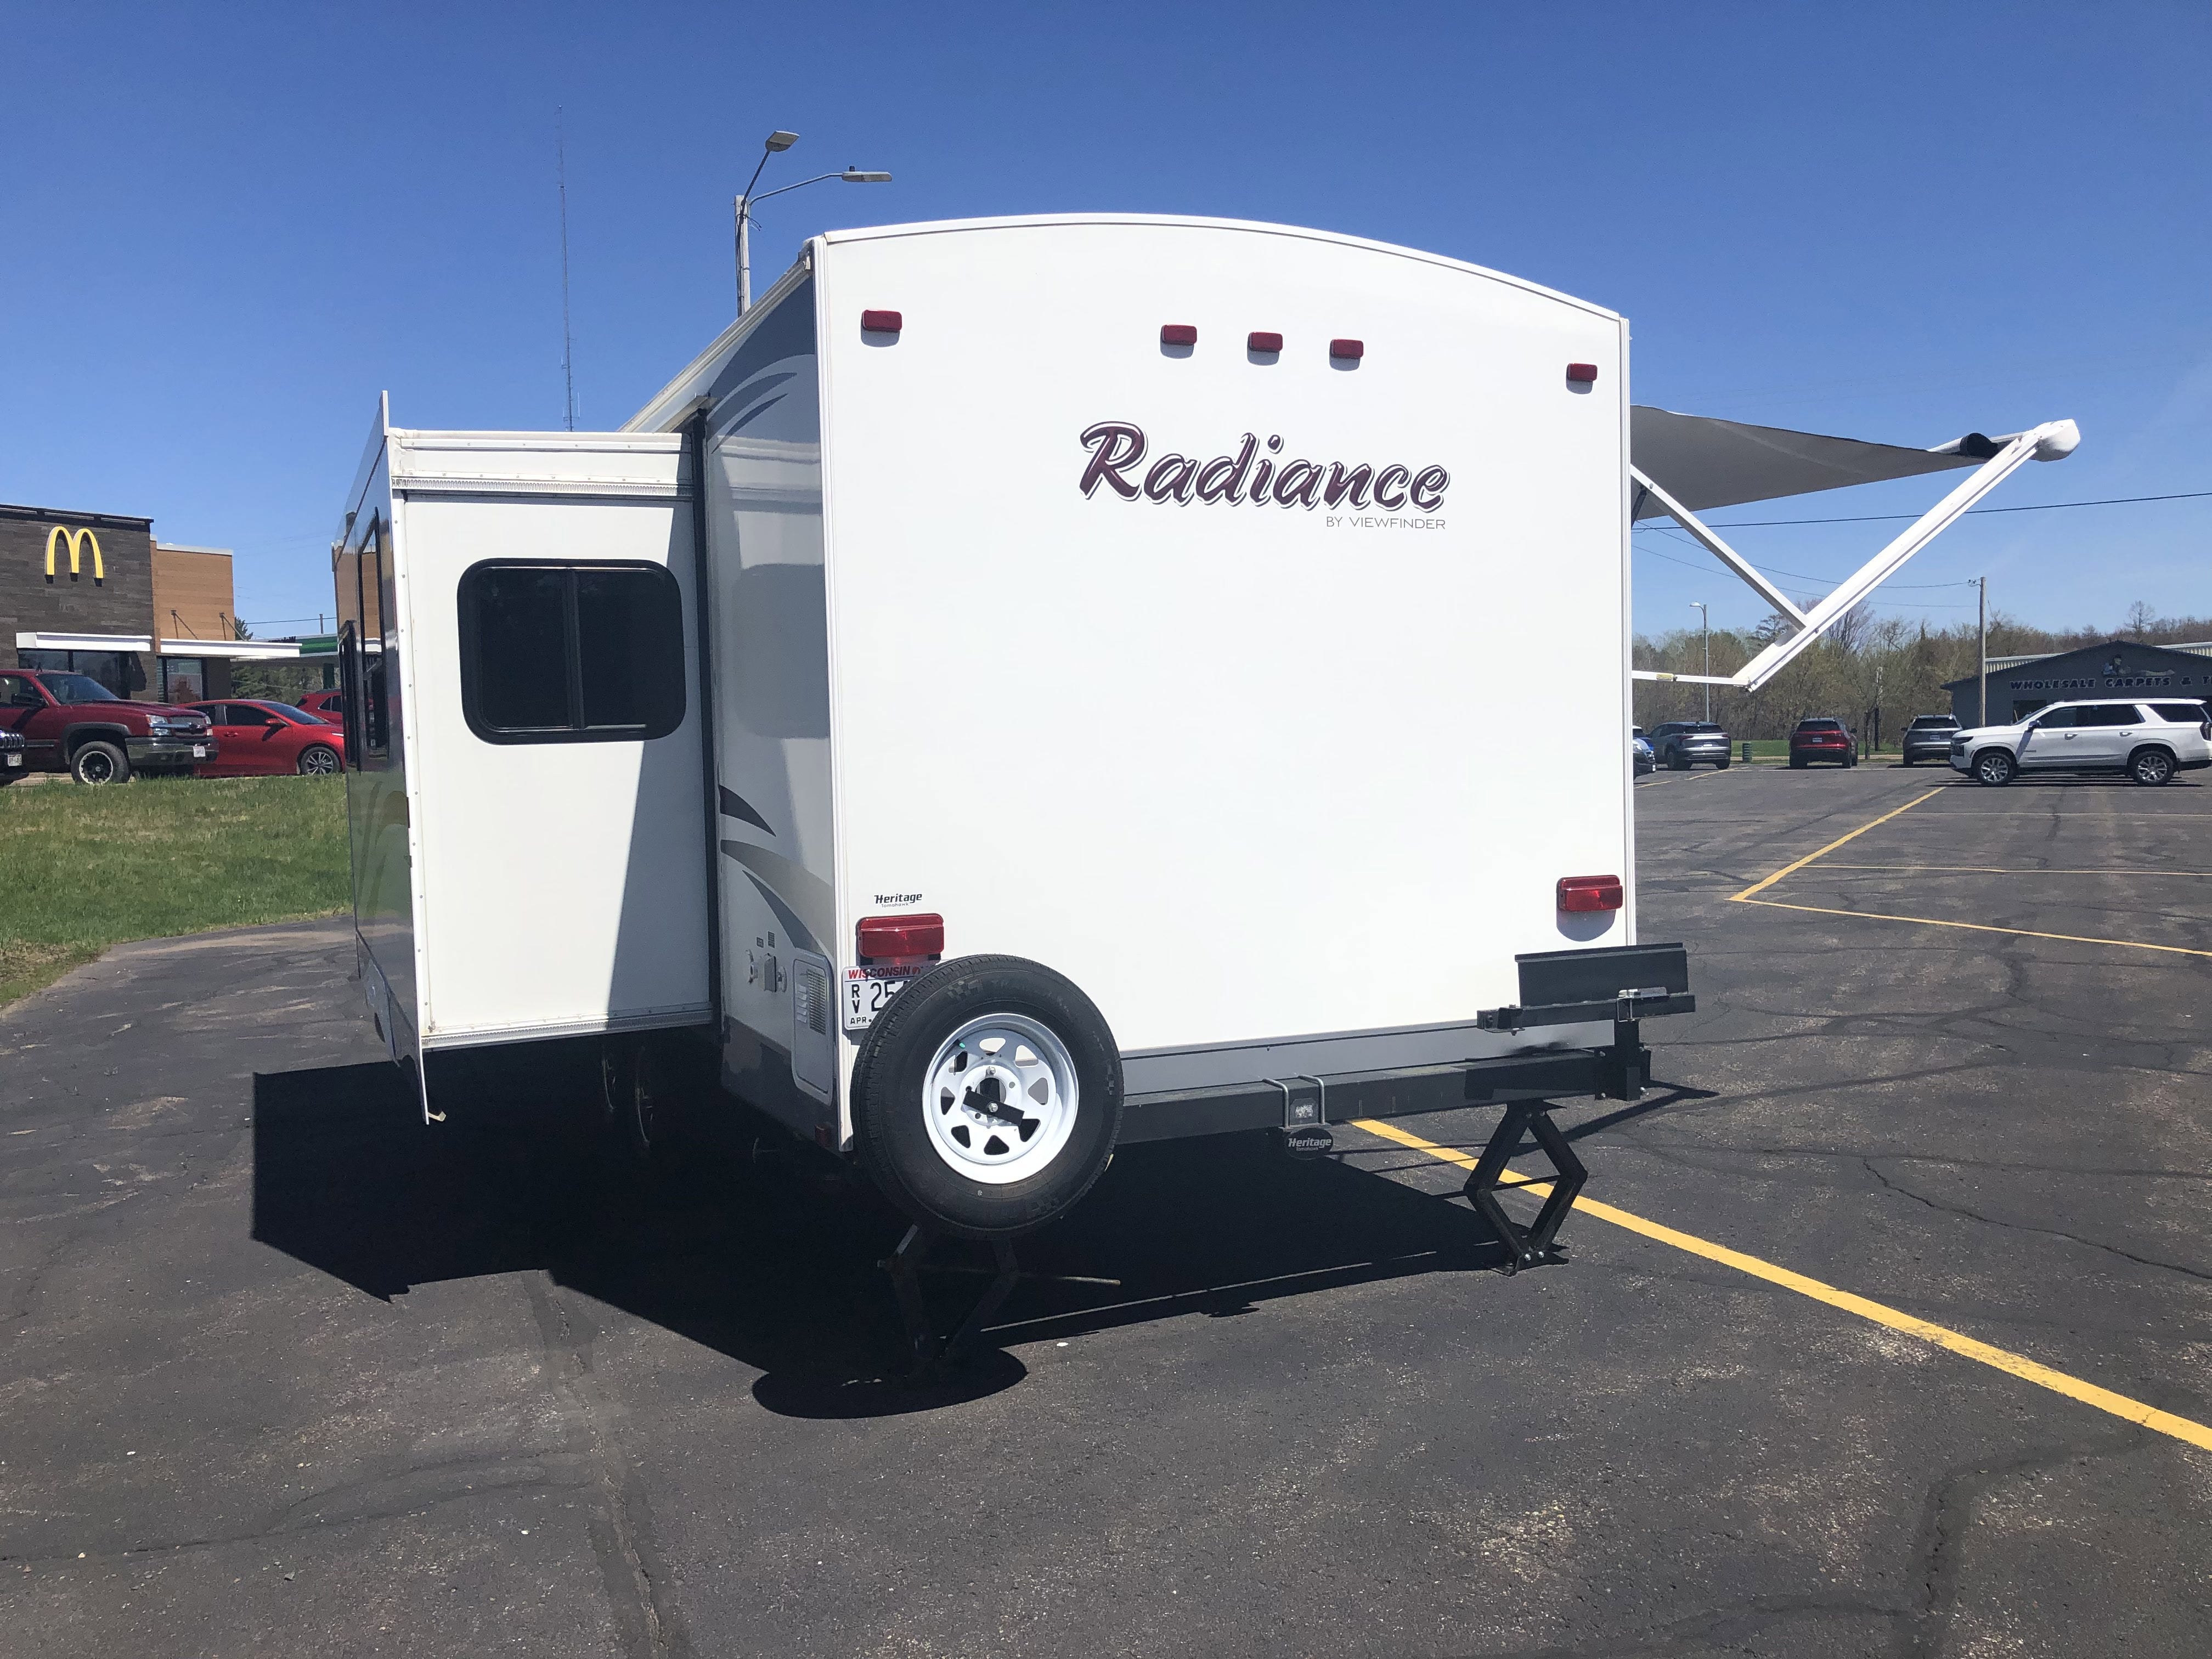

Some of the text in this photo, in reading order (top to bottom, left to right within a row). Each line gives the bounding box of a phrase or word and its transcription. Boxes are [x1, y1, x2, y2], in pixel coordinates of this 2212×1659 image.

[1079, 420, 1450, 514] Radiance
[1327, 516, 1446, 529] BY VIEWFINDER
[2009, 678, 2096, 690] WHOLESALE
[2105, 676, 2171, 687] CARPETS
[874, 893, 922, 904] Heritage
[848, 966, 911, 979] WISCONSIN
[850, 1016, 867, 1024] APR
[1288, 1137, 1332, 1148] Heritage
